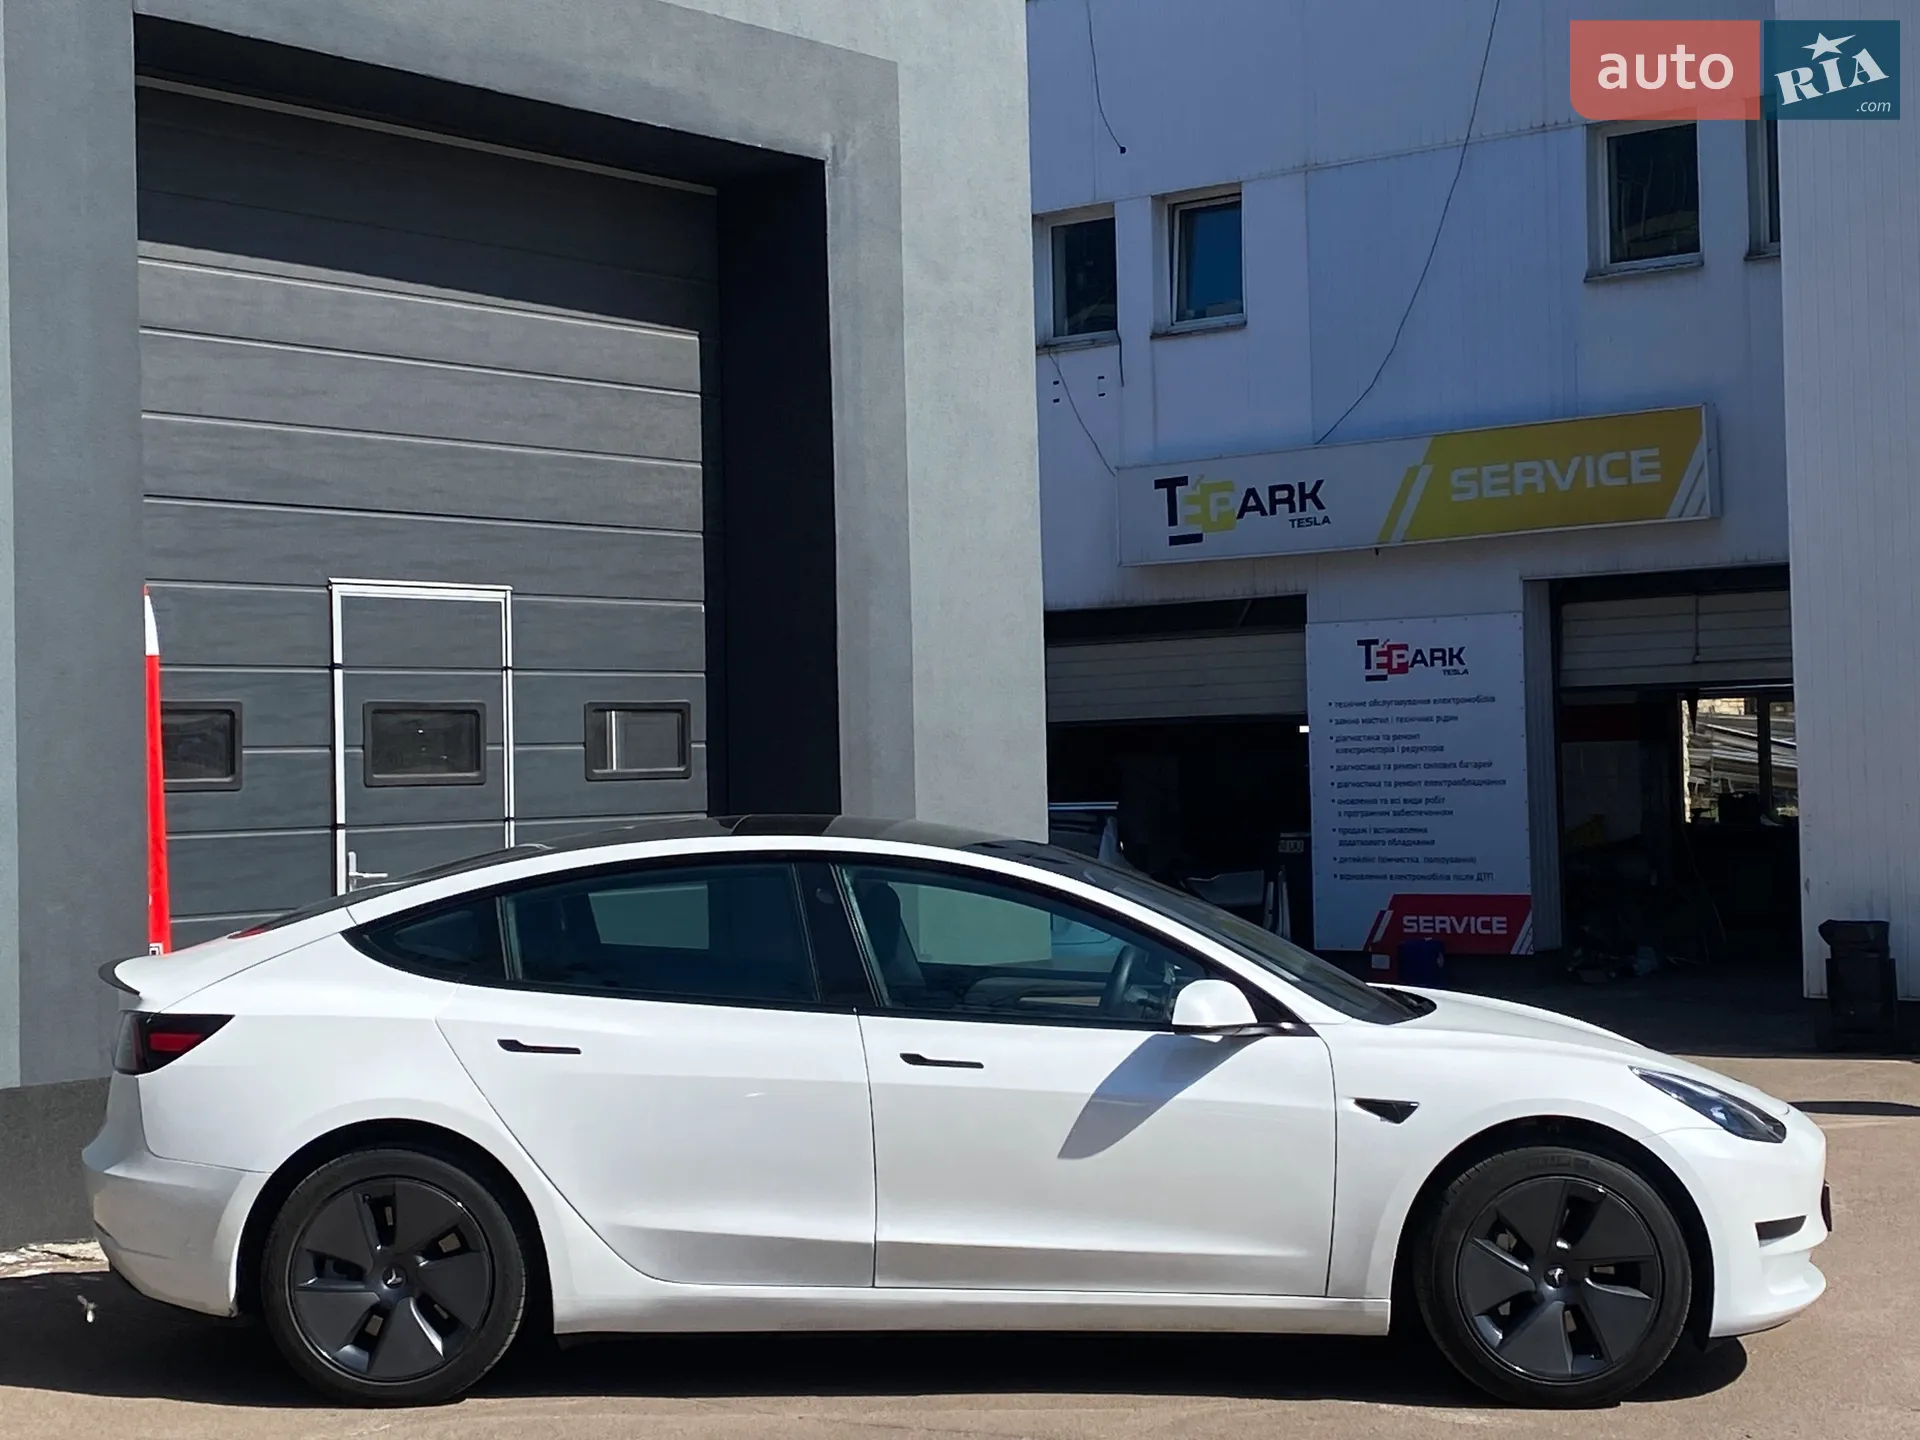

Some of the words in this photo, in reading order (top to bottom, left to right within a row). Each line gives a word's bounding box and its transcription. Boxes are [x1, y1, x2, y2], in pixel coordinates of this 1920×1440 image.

[1450, 447, 1661, 502] SERVICE
[1289, 515, 1331, 529] TESLA
[1335, 733, 1380, 743] діагностика
[1392, 733, 1420, 742] ремонт
[1401, 744, 1444, 753] редукторів
[1336, 763, 1380, 772] діагностика
[1393, 763, 1421, 771] ремонт
[1459, 760, 1492, 769] батарей
[1336, 780, 1381, 789] діагностика
[1394, 780, 1422, 788] ремонт
[1424, 796, 1445, 806] робіт
[1476, 873, 1494, 882] ДТП
[1403, 916, 1507, 935] SERVICE
